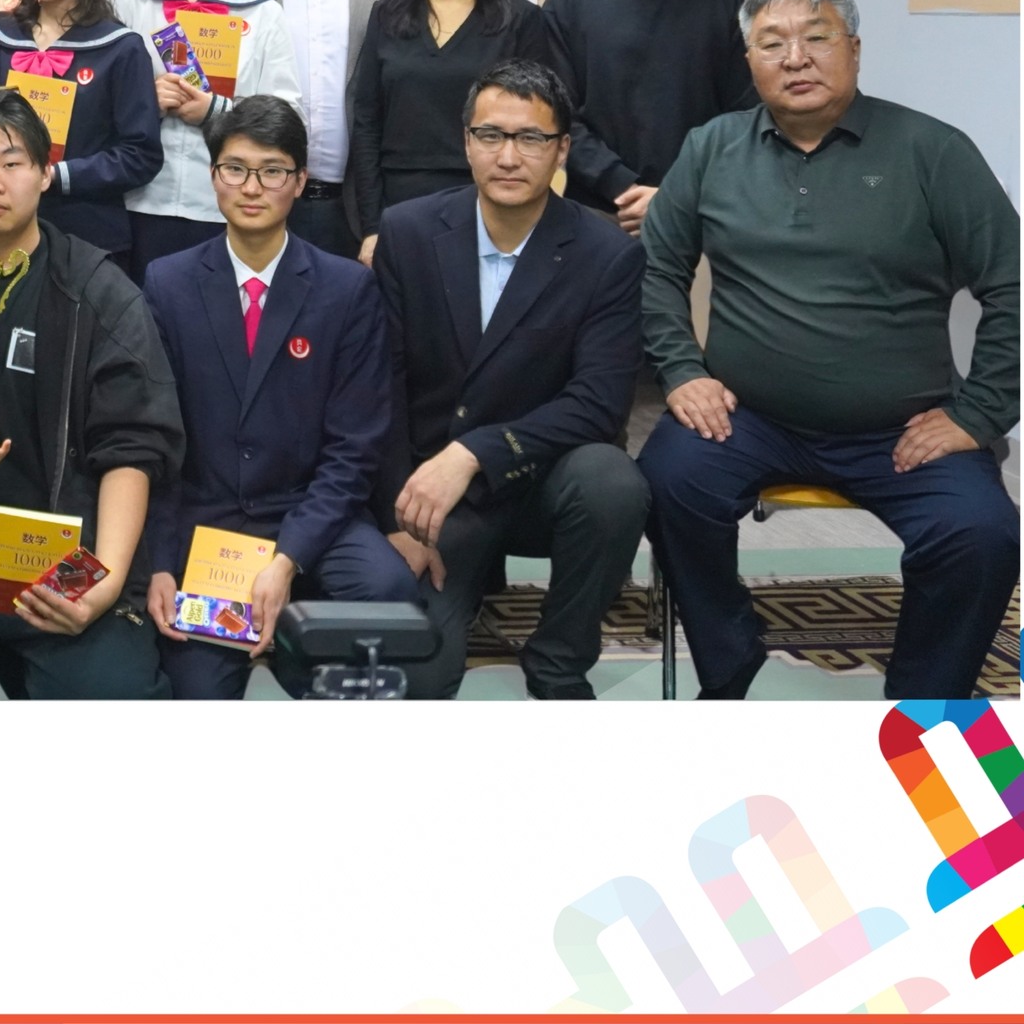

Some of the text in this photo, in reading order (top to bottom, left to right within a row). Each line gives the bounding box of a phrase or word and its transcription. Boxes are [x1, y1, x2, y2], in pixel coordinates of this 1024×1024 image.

[199, 27, 219, 39] 数学
[29, 89, 50, 101] 数学
[22, 533, 48, 546] 数学
[14, 552, 52, 569] 1000
[219, 548, 243, 561] 数学
[208, 567, 245, 585] 1000
[186, 601, 195, 622] Alpen
[194, 604, 203, 622] Gold
